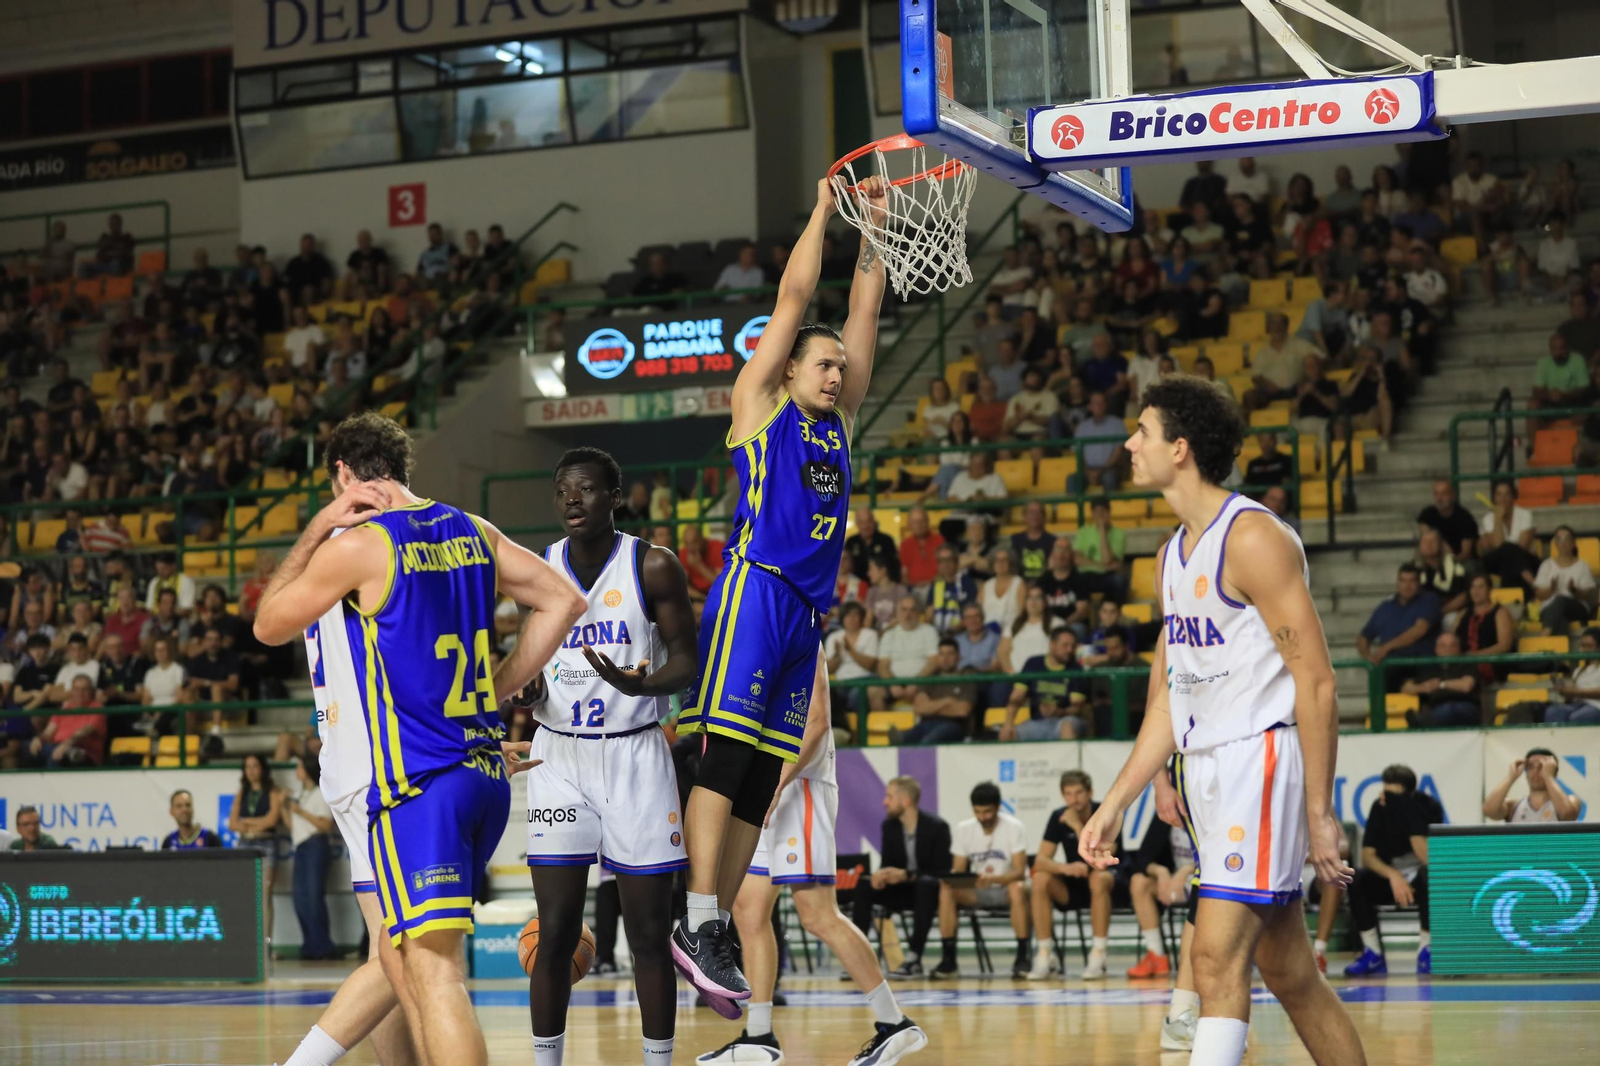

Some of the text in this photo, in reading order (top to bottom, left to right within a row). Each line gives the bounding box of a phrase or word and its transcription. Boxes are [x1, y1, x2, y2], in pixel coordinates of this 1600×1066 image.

[264, 0, 672, 51] DEPUT
[1109, 100, 1341, 141] BricoCentro
[397, 190, 416, 220] 3
[643, 318, 723, 341] PARQUE
[643, 335, 725, 359] BARBAÑA
[542, 398, 608, 421] SAIDA
[810, 513, 838, 540] 27
[398, 536, 489, 575] MCDONNELL
[434, 629, 499, 718] 24
[571, 698, 605, 727] 12
[29, 885, 69, 900] GRUPO
[29, 896, 224, 942] IBEREÓLICA
